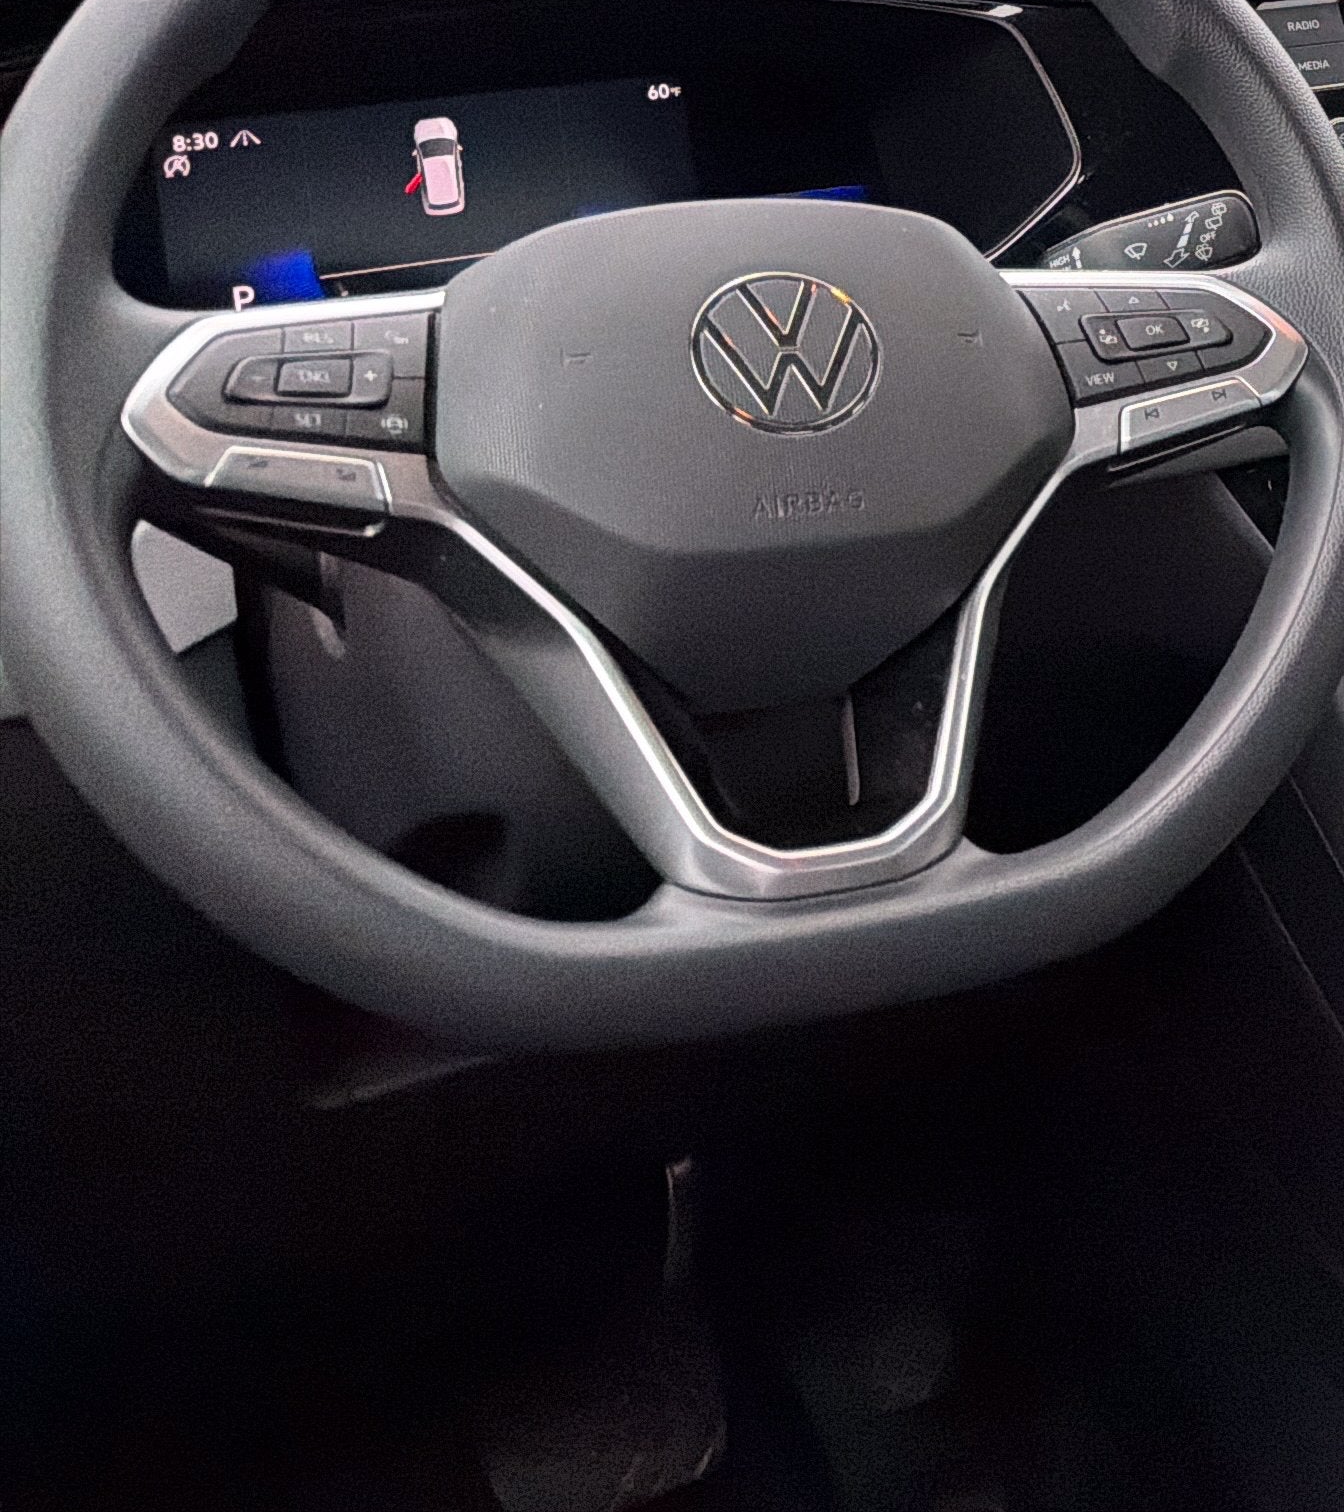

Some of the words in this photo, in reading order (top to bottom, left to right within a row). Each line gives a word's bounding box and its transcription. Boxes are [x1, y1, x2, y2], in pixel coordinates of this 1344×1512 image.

[1287, 19, 1320, 31] RADIO
[1298, 59, 1330, 71] MEDIA
[172, 131, 219, 153] 8:30
[1200, 231, 1217, 243] OFF
[1049, 254, 1070, 269] HIGH
[232, 285, 255, 313] P
[1145, 323, 1164, 336] OK
[1085, 372, 1115, 386] VIEW
[754, 489, 866, 519] AIRBAG
